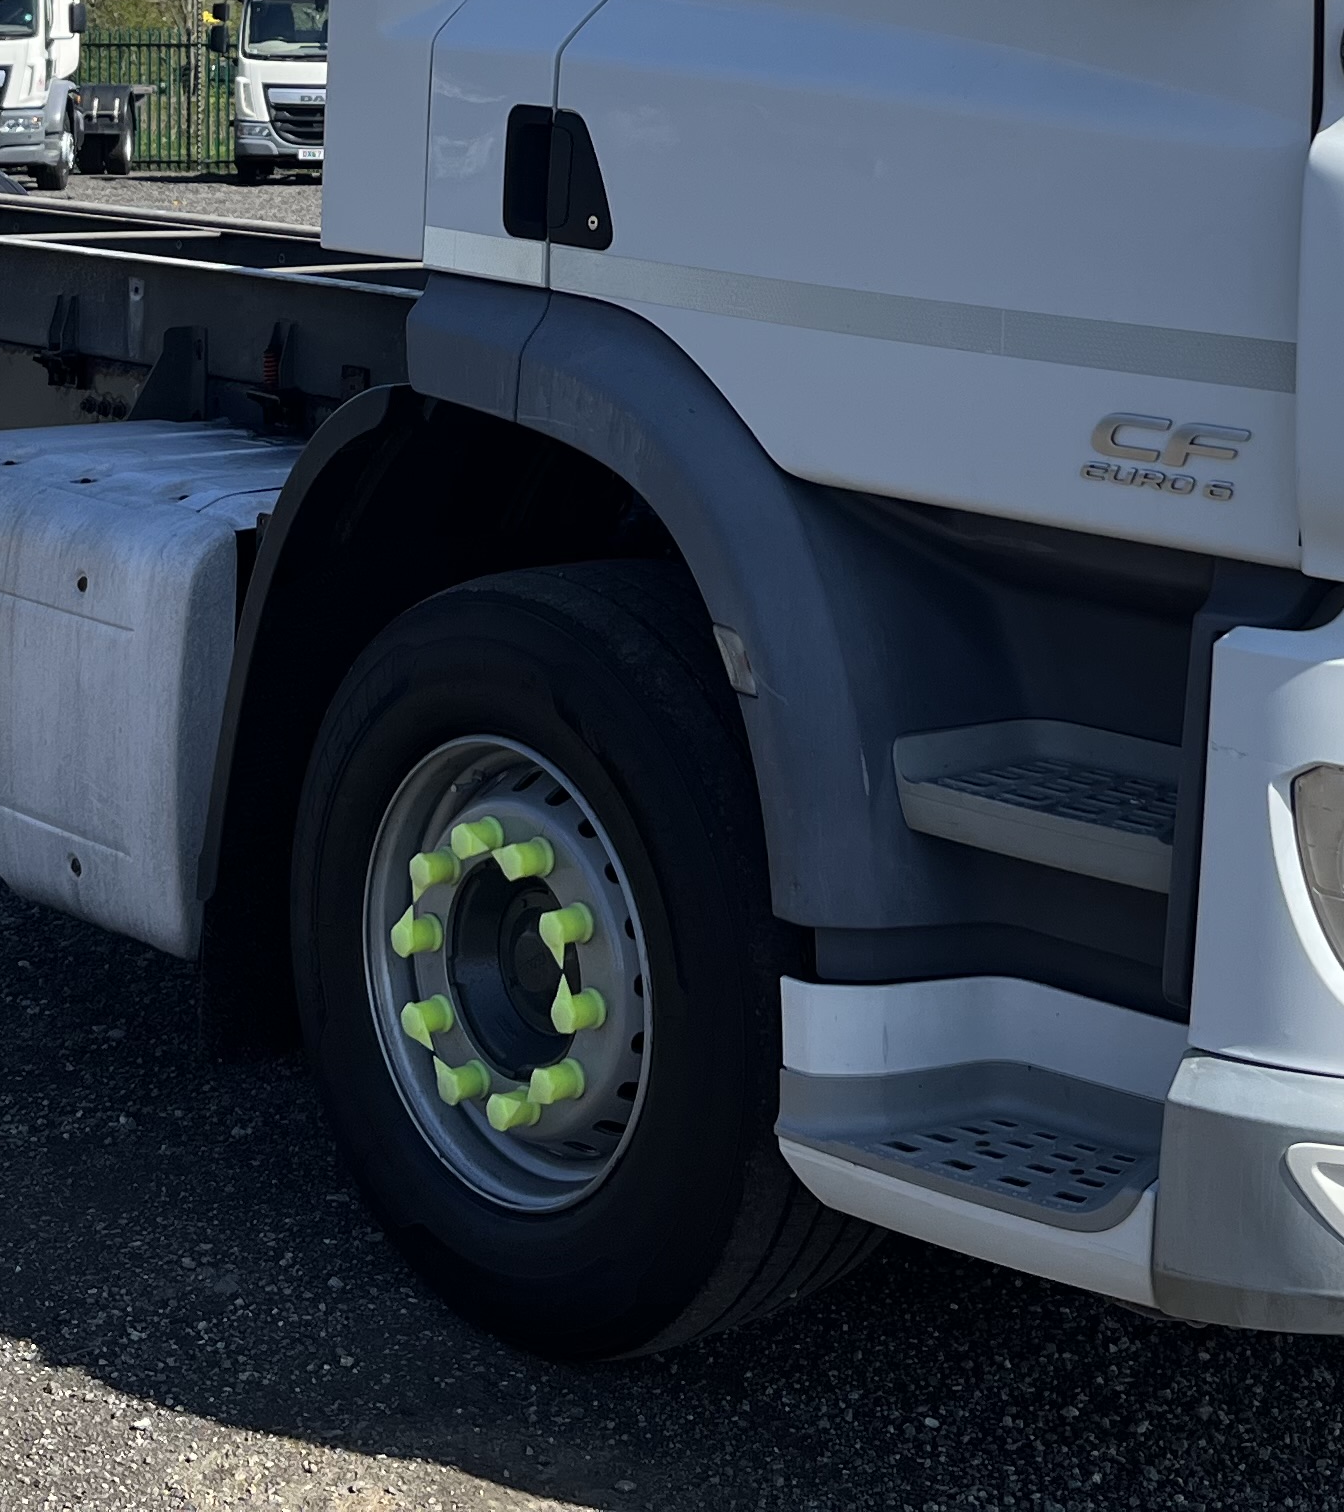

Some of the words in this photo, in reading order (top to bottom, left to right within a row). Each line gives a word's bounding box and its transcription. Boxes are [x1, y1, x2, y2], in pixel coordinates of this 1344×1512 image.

[1090, 412, 1253, 468] CF
[1079, 460, 1198, 496] EURO
[1202, 479, 1235, 501] 6
